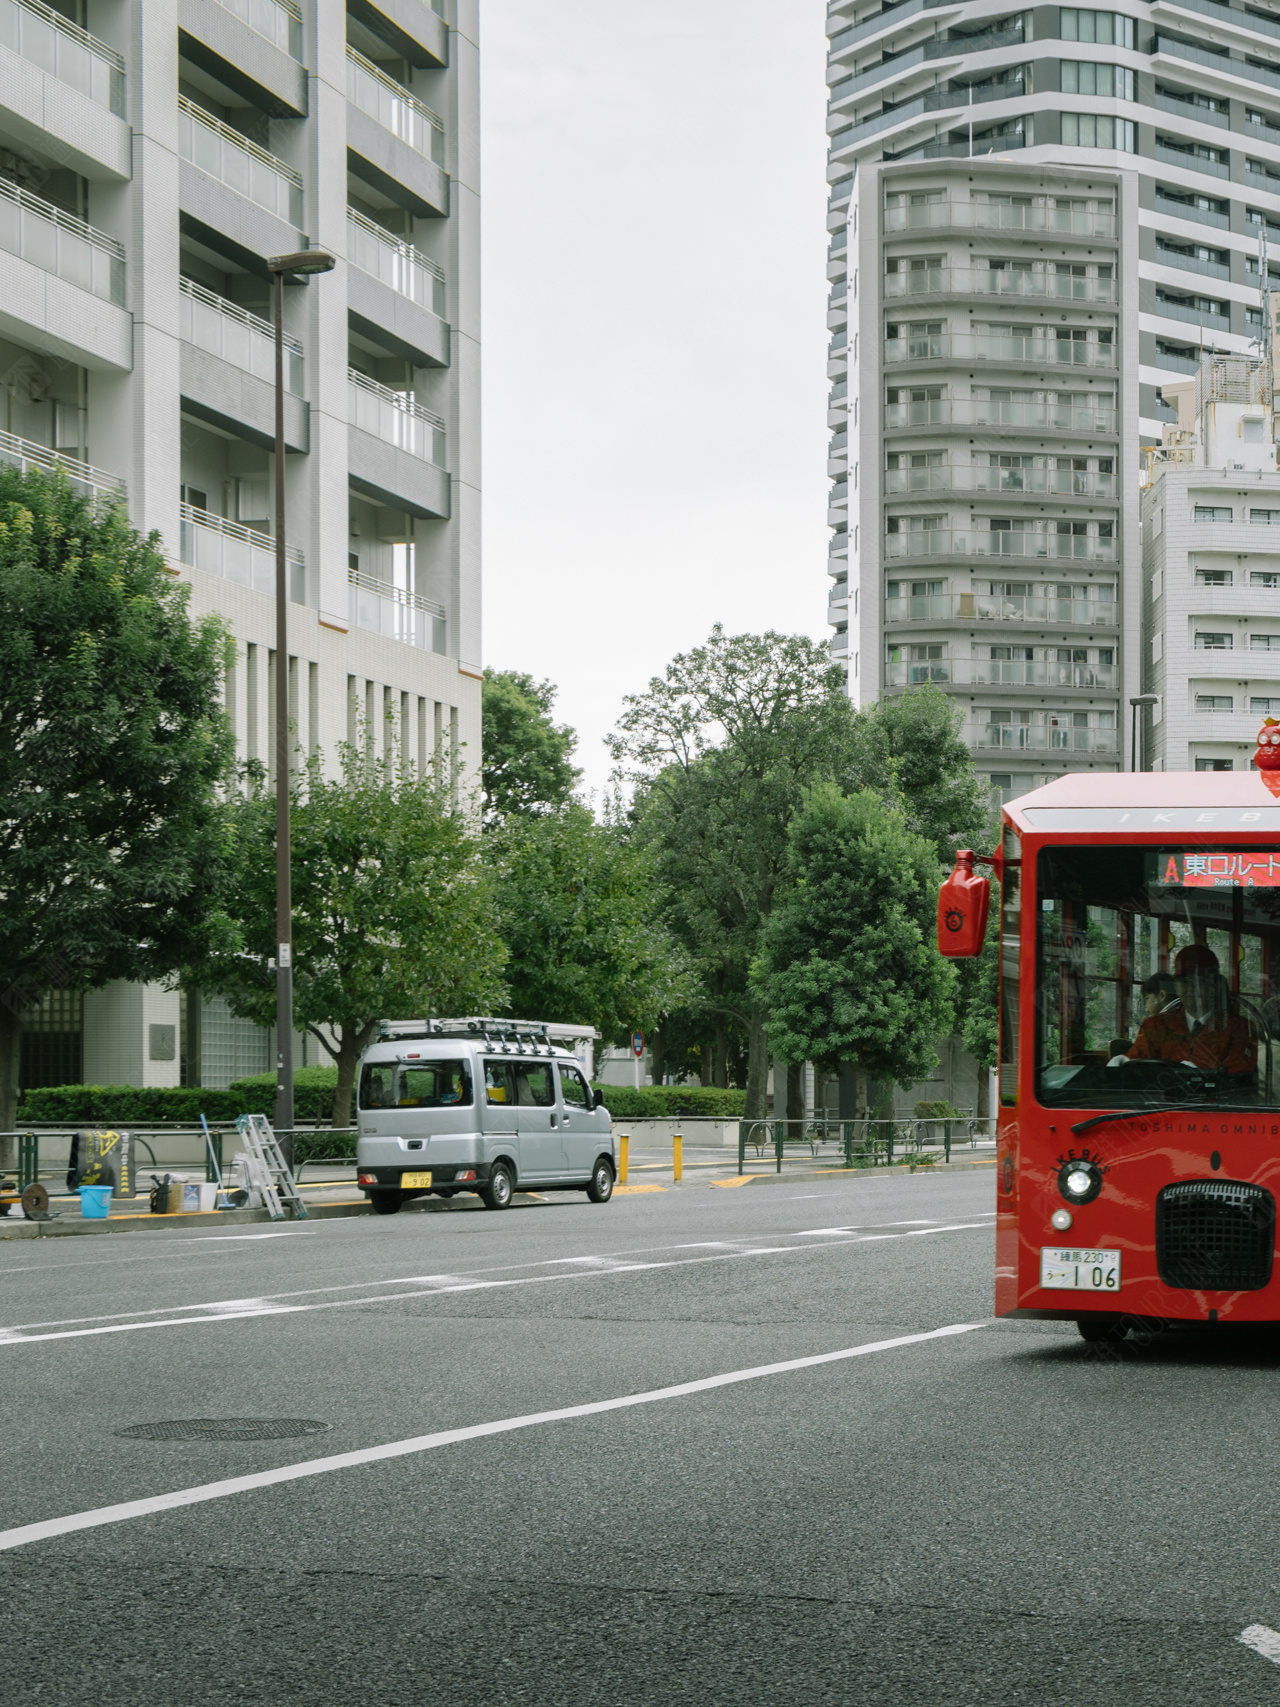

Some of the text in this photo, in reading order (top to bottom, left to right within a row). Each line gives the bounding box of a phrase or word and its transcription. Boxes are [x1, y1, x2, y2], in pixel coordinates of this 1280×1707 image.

[1164, 855, 1180, 883] A
[1214, 877, 1254, 886] Route A
[1129, 1122, 1210, 1134] TOSHIMA
[1084, 1252, 1104, 1264] 230
